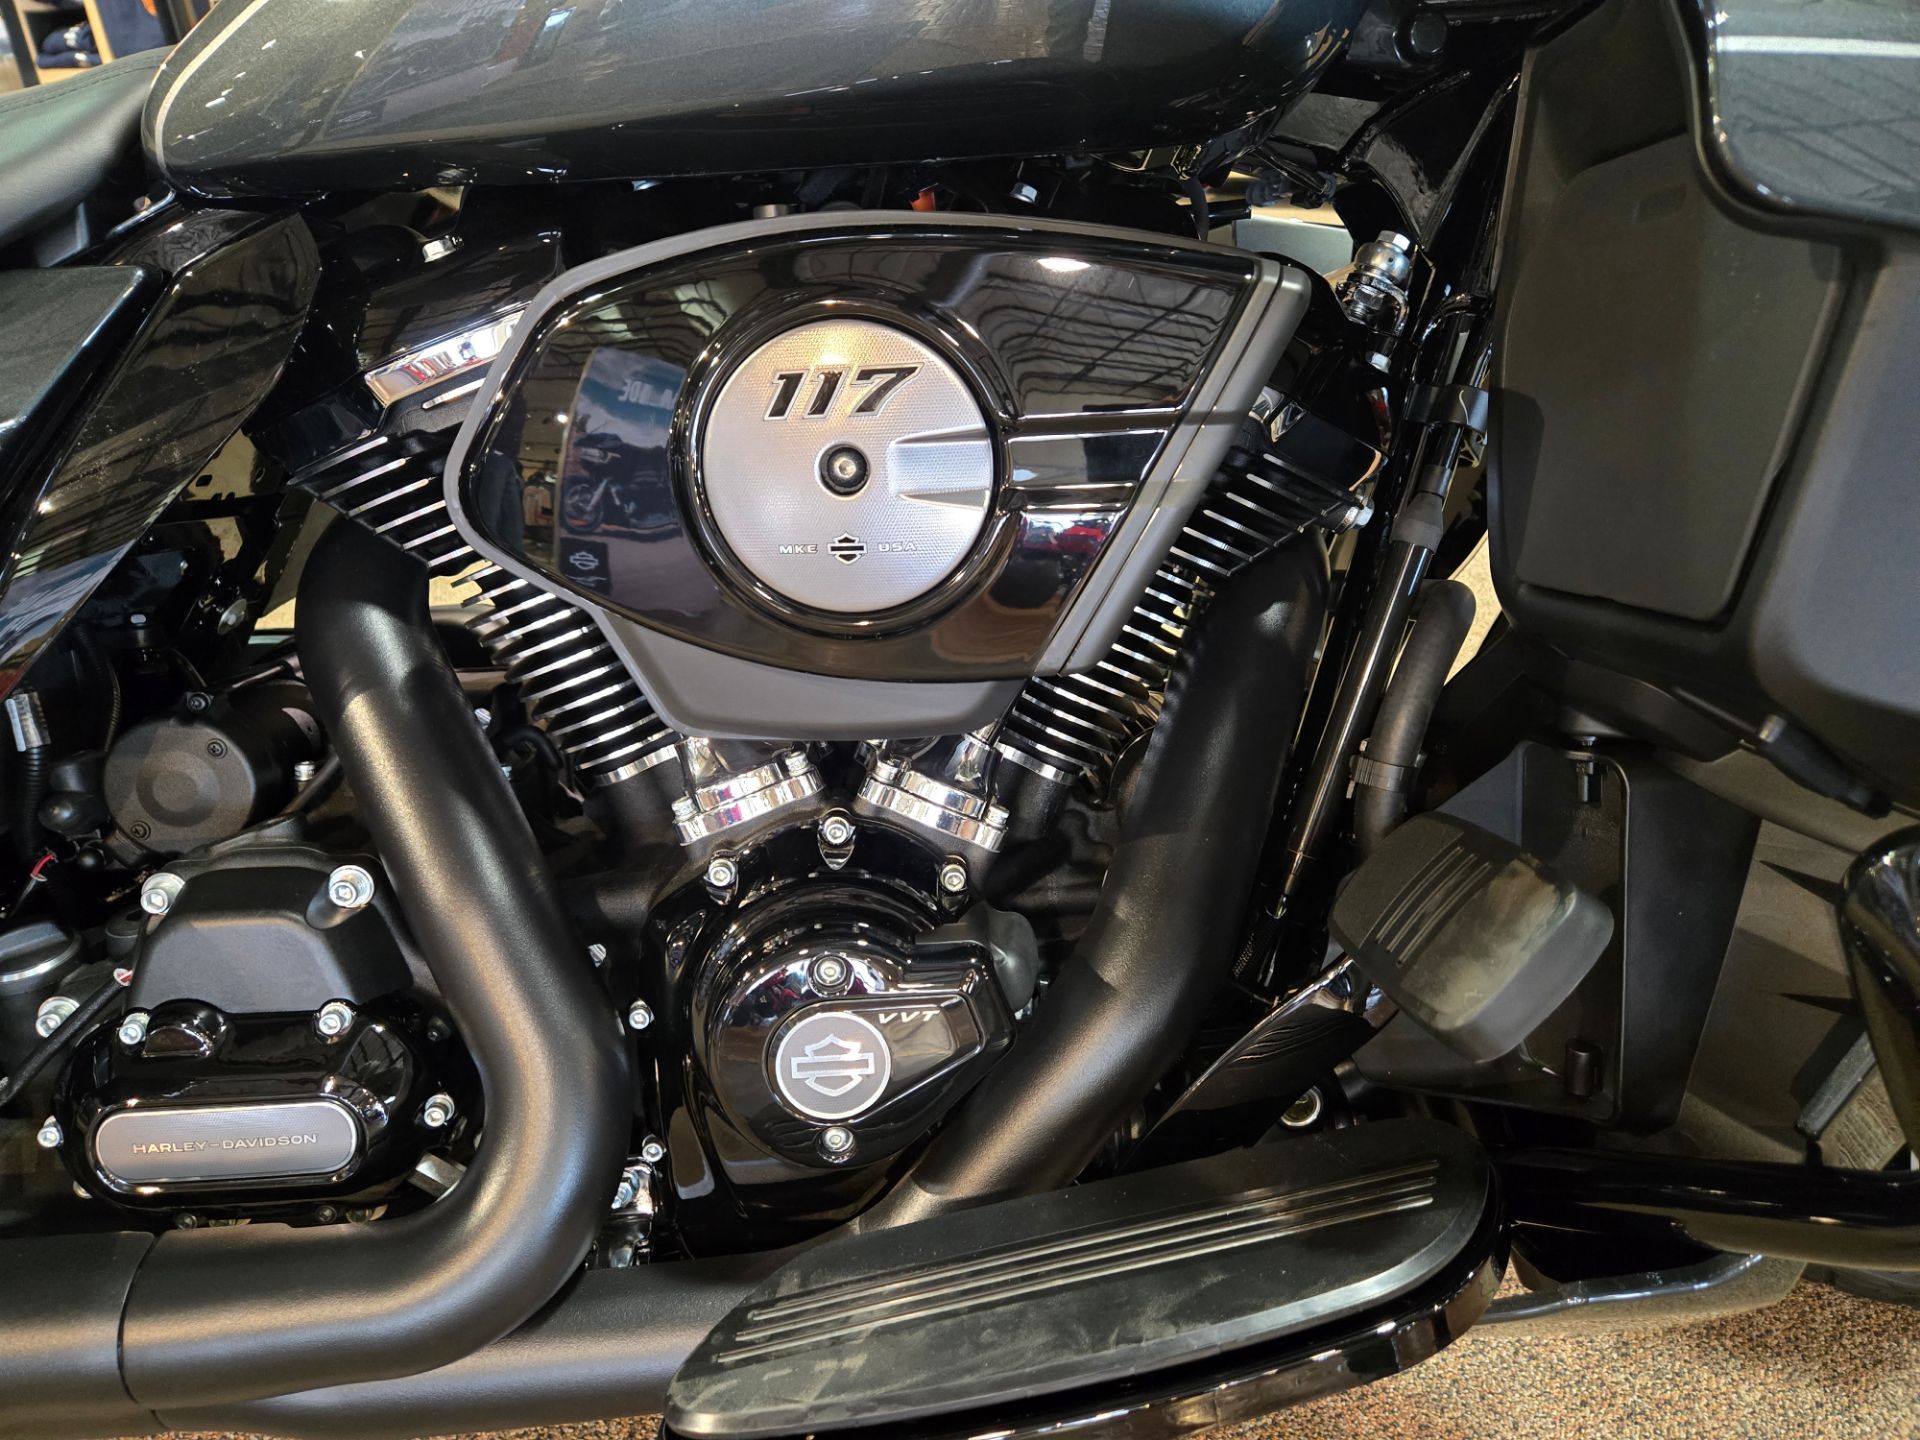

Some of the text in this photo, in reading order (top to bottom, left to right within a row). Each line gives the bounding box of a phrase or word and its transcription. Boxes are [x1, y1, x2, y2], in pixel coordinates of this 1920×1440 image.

[763, 362, 925, 421] 117
[779, 541, 917, 554] MKE USA
[878, 1010, 941, 1024] VVT
[132, 1133, 318, 1155] HARLEY-DAVIDSON
